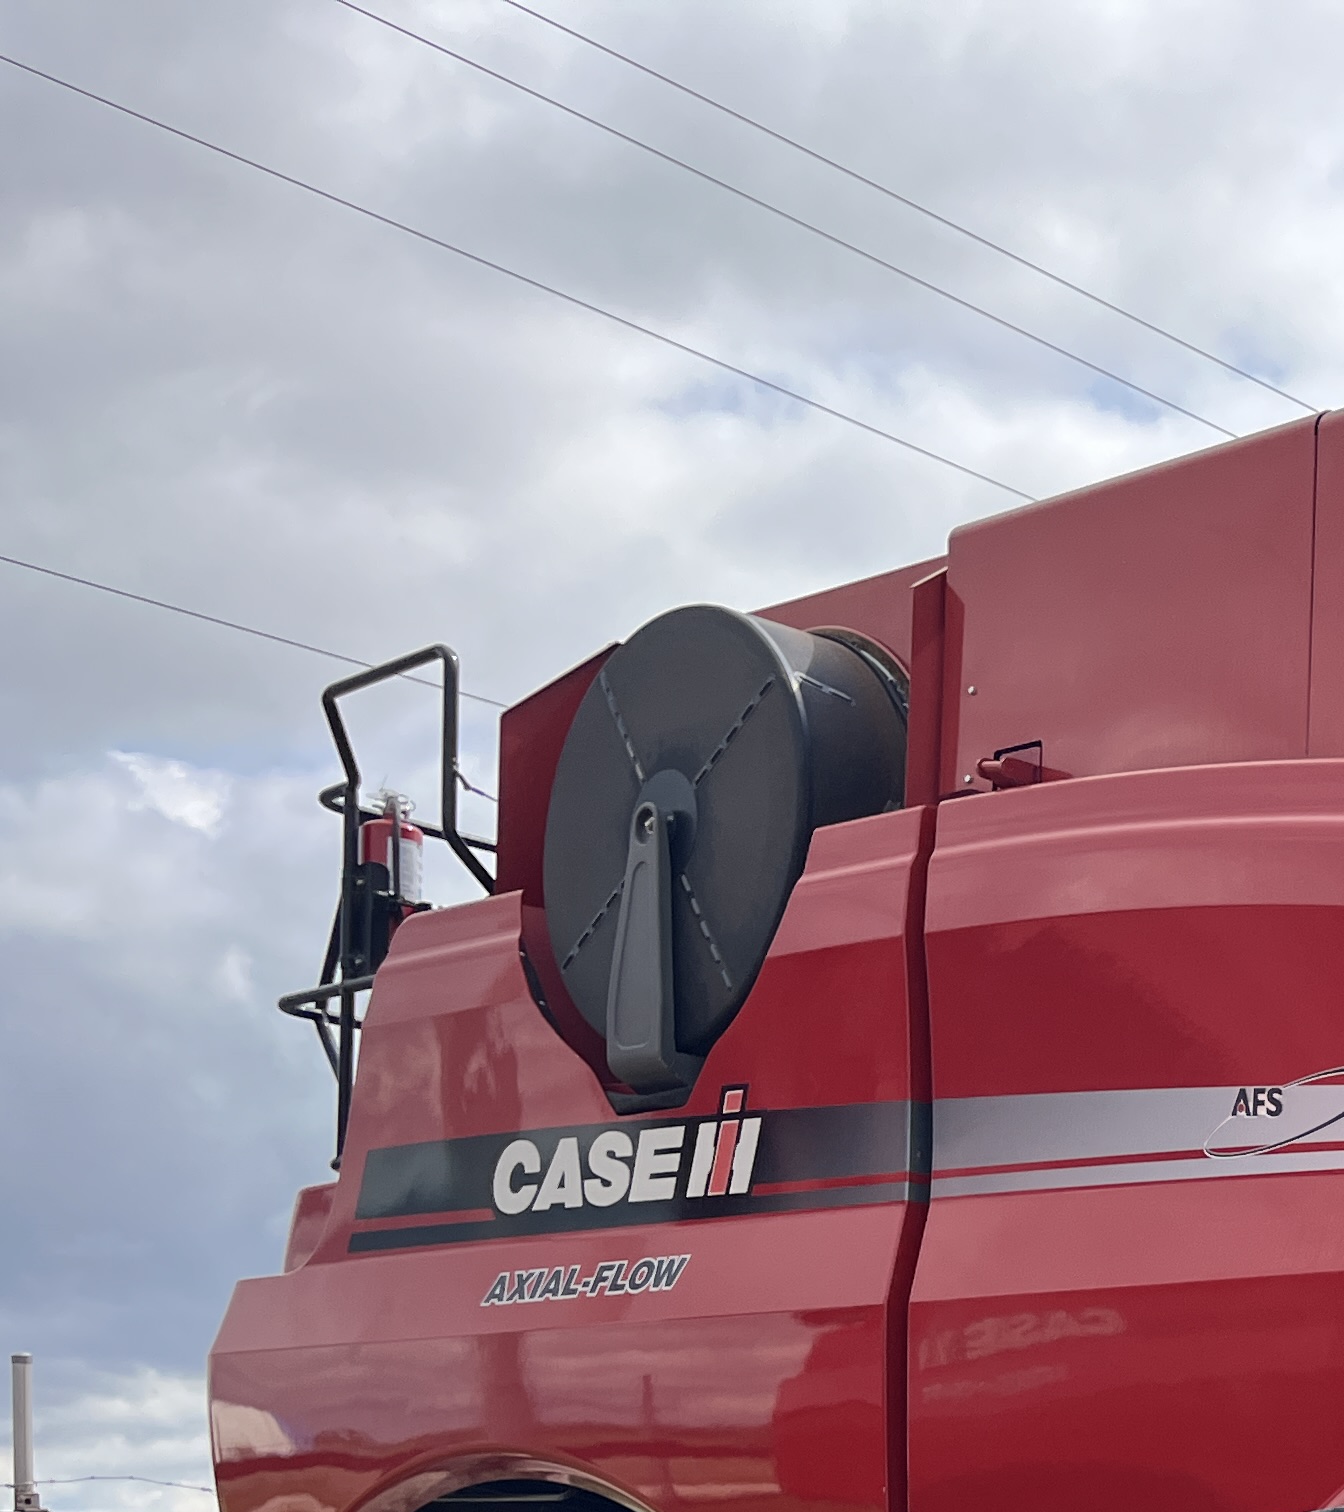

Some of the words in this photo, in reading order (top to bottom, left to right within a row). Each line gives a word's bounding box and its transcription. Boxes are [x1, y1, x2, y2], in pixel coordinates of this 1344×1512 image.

[1232, 1087, 1284, 1118] AFS
[493, 1125, 686, 1216] CASE
[480, 1253, 692, 1307] AXIAL-FLOW
